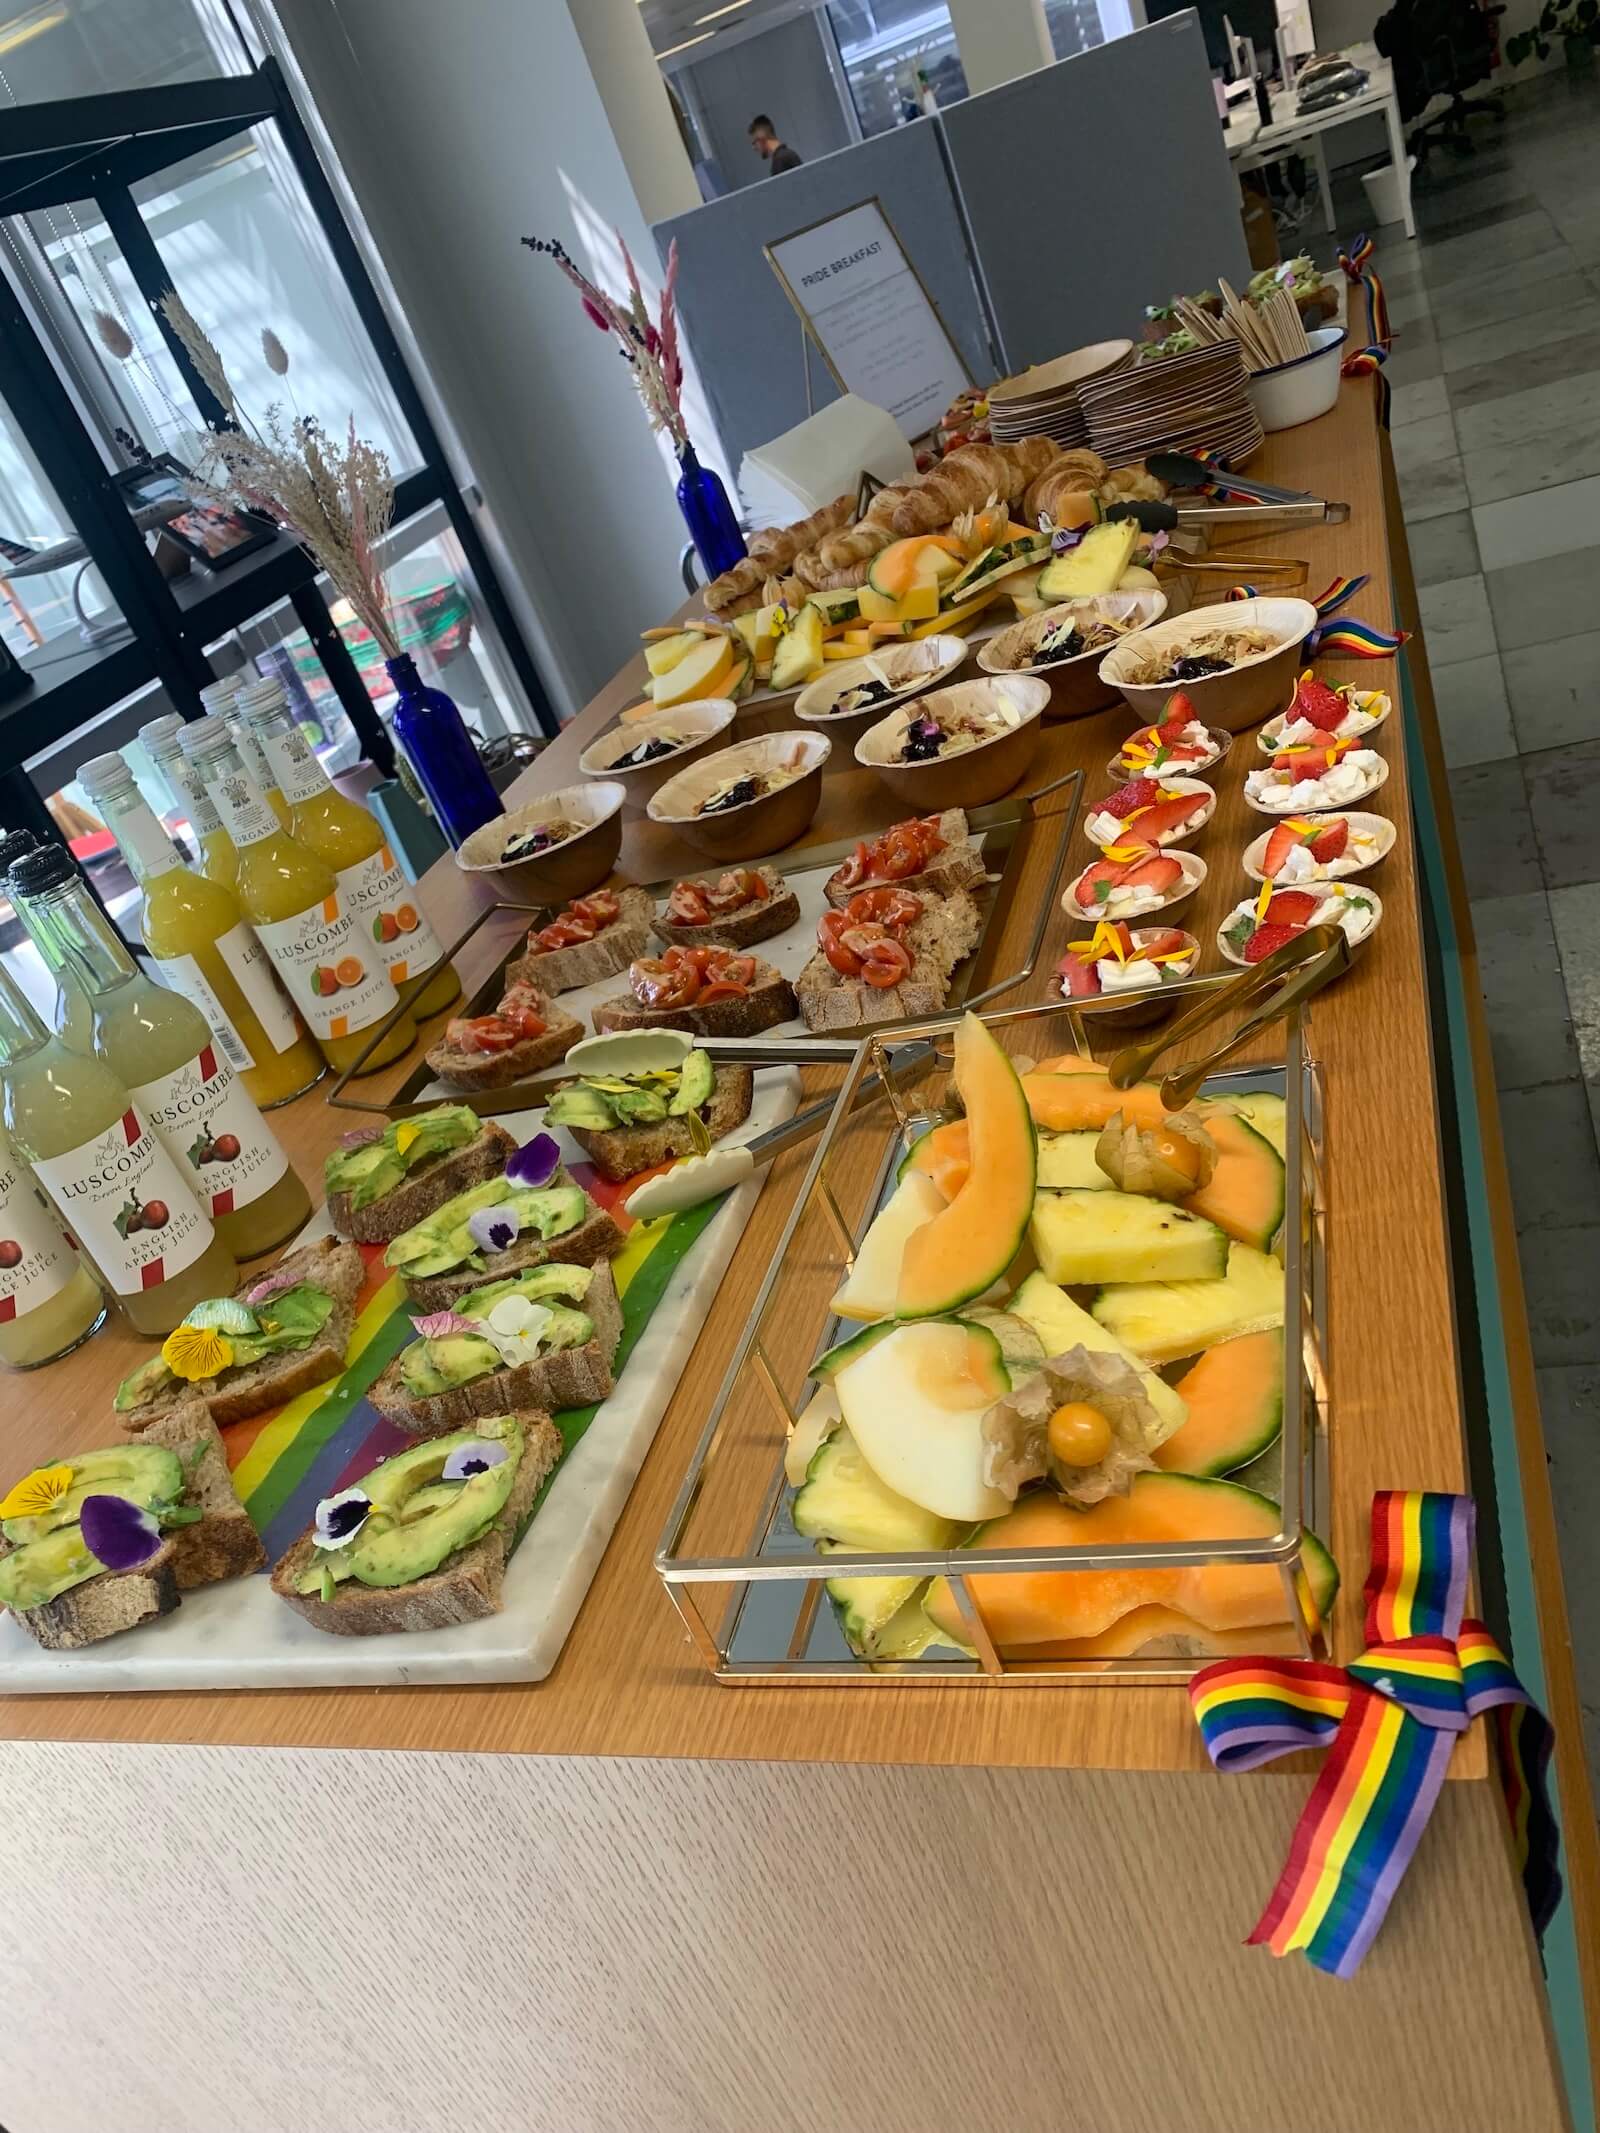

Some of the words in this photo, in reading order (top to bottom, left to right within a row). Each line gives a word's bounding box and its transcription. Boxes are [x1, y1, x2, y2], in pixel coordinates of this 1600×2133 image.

[801, 267, 831, 287] PRIDE
[830, 241, 882, 274] BREAKFAST
[234, 817, 278, 843] ORGANIC
[275, 912, 354, 960] LUSCOMBE
[382, 944, 416, 964] RANGE
[314, 999, 357, 1019] ORANGE
[360, 979, 385, 1004] JUICE
[149, 1065, 234, 1127] USCOMBE
[164, 1117, 196, 1134] Devon
[198, 1090, 231, 1120] England
[61, 1131, 157, 1200] LUSCOMBE
[89, 1184, 122, 1204] Devon
[124, 1154, 155, 1188] England
[195, 1174, 238, 1199] APPLE
[242, 1146, 272, 1179] JUICE
[203, 1145, 260, 1184] ENGLISH
[124, 1243, 168, 1271] APPLE
[172, 1213, 200, 1247] JUICE
[131, 1211, 189, 1256] ENGLISH
[25, 1251, 59, 1286] JUICE
